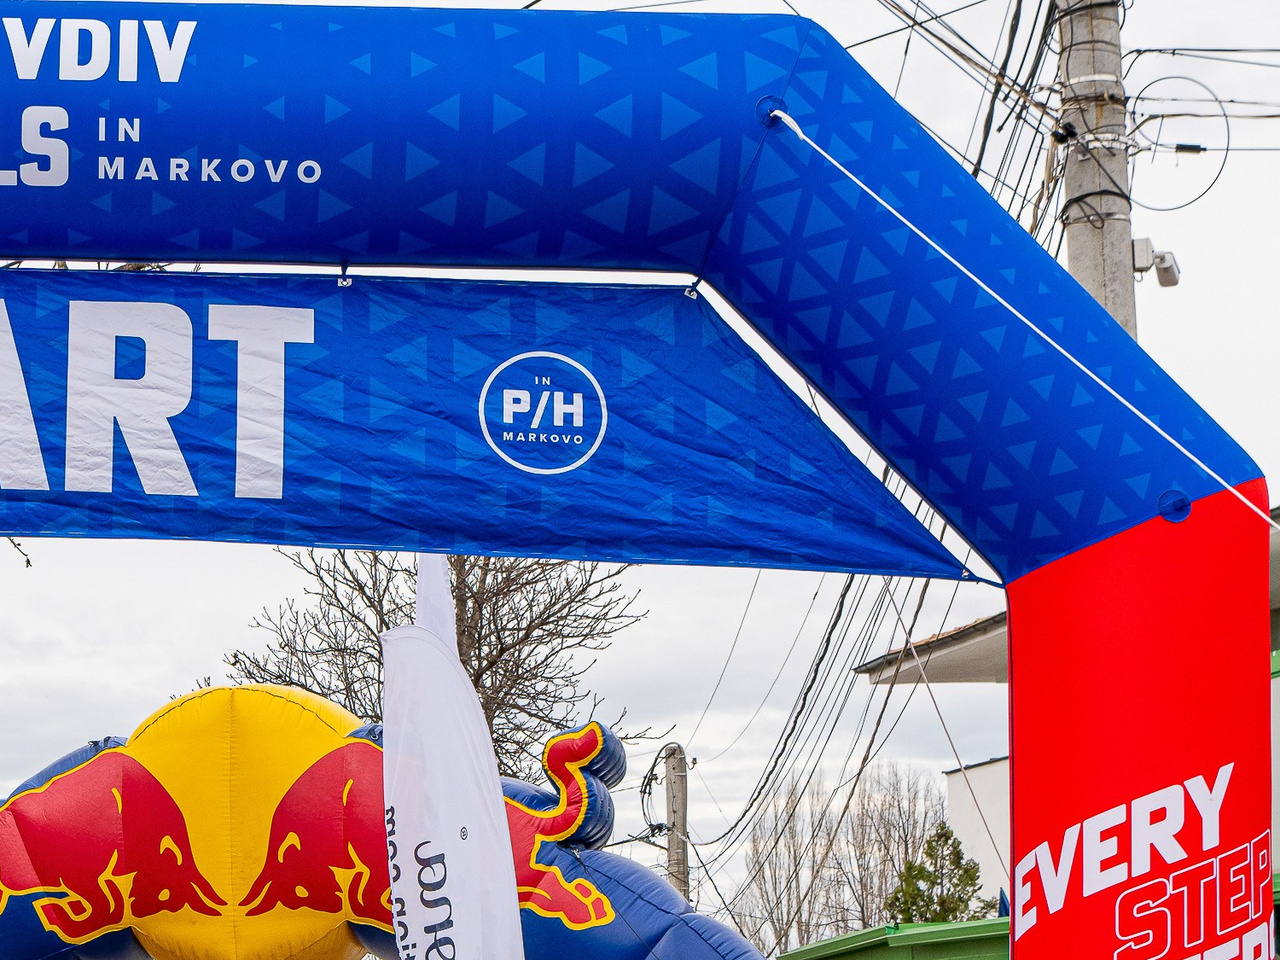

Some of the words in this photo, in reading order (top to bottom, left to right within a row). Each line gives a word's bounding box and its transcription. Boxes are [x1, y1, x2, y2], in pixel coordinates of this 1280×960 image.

[98, 117, 141, 143] IN
[97, 157, 323, 184] MARKOVO
[534, 375, 551, 385] IN
[503, 388, 584, 429] P/H
[503, 431, 583, 445] MARKOVO
[1014, 761, 1235, 942] EVERY
